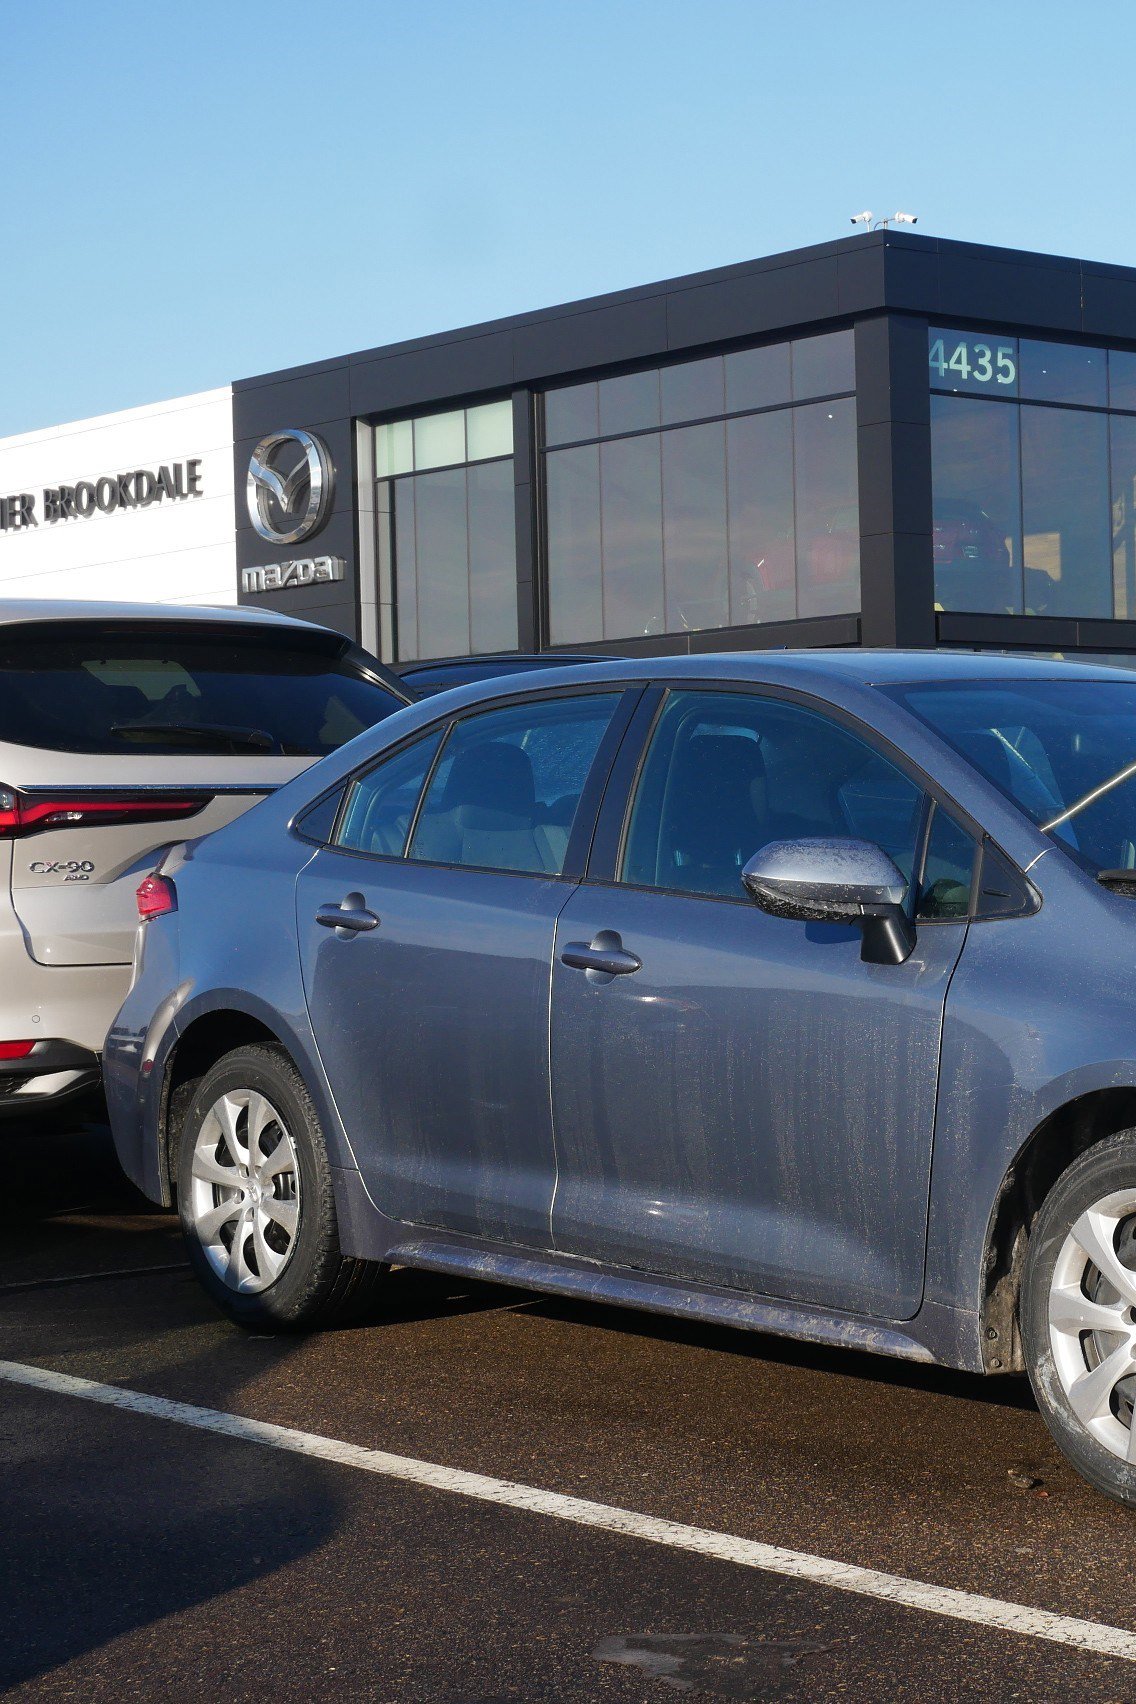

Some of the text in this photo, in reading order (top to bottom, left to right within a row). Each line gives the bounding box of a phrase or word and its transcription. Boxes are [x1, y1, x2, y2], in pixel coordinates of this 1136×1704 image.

[929, 338, 1017, 385] 4435
[43, 458, 204, 524] BROOKDALE
[29, 860, 96, 874] CX-90
